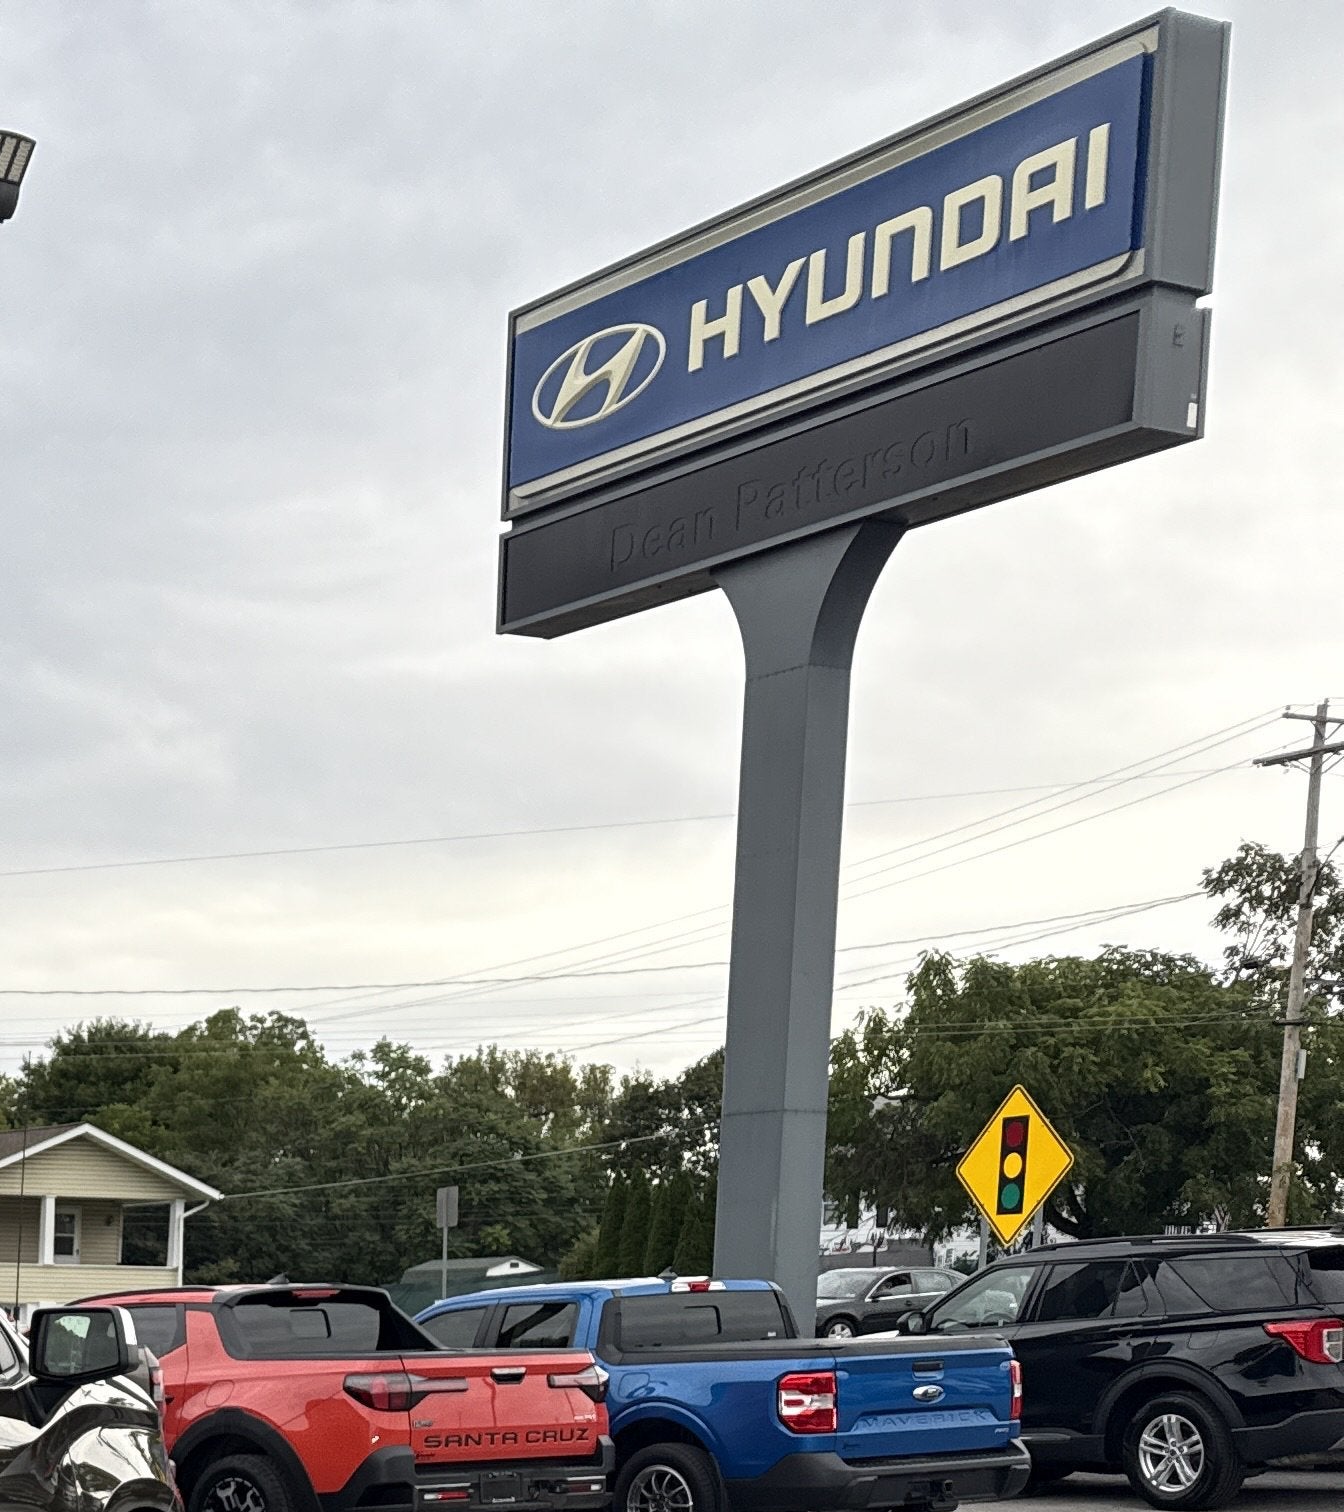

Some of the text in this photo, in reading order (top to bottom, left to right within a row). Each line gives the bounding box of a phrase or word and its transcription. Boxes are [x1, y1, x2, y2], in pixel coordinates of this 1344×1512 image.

[687, 122, 1111, 373] HYUNDAI
[610, 417, 974, 572] Dean Patterson
[423, 1427, 590, 1449] SANTA CRUZ
[859, 1409, 989, 1429] MAVERICK
